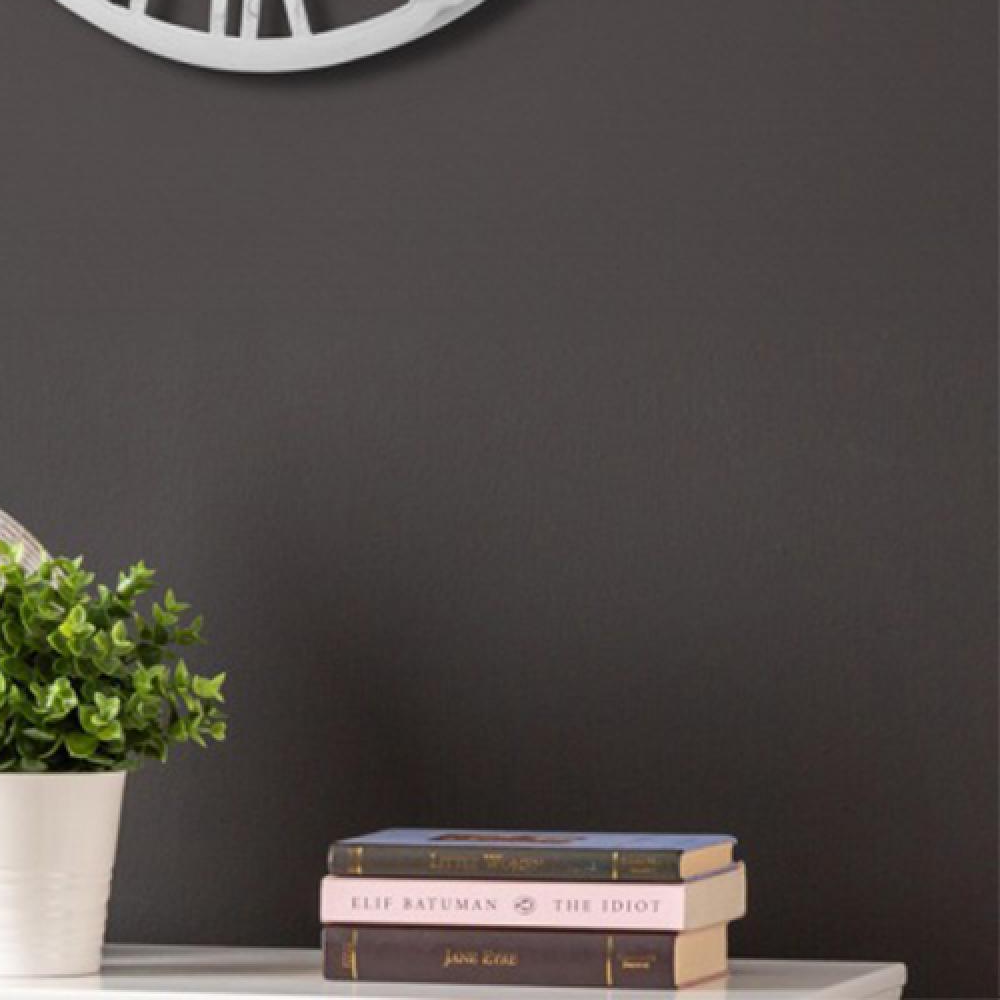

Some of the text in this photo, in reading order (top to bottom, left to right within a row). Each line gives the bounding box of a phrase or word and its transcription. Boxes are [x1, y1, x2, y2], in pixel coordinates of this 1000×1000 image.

[351, 896, 497, 912] ELIF BATUMAN
[553, 899, 661, 913] THE IDIOT
